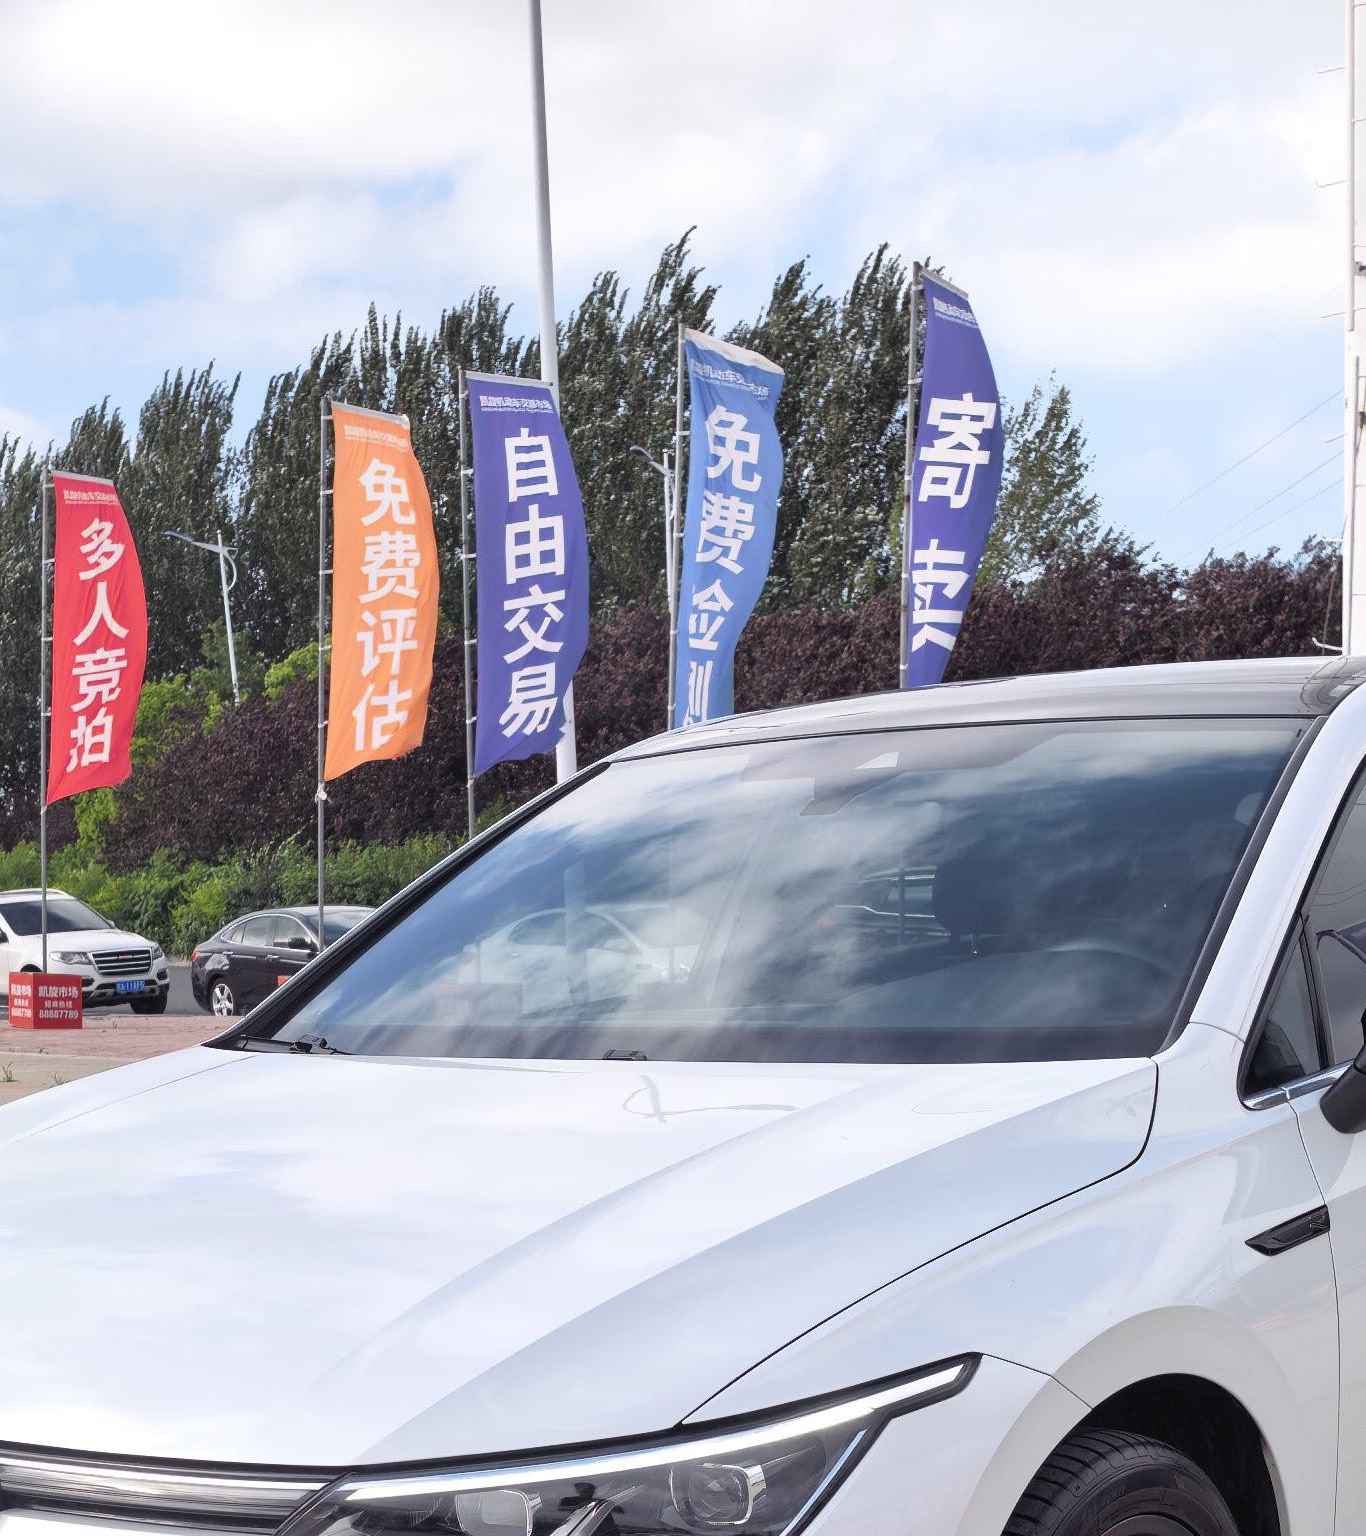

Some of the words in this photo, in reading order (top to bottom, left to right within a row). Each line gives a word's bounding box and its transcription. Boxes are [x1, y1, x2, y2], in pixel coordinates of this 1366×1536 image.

[66, 518, 129, 773] 多人竞拍
[351, 457, 422, 753] 免费评估
[499, 427, 566, 740] 自由交易
[912, 393, 996, 653] 寄卖
[38, 985, 79, 998] 凯旋市场
